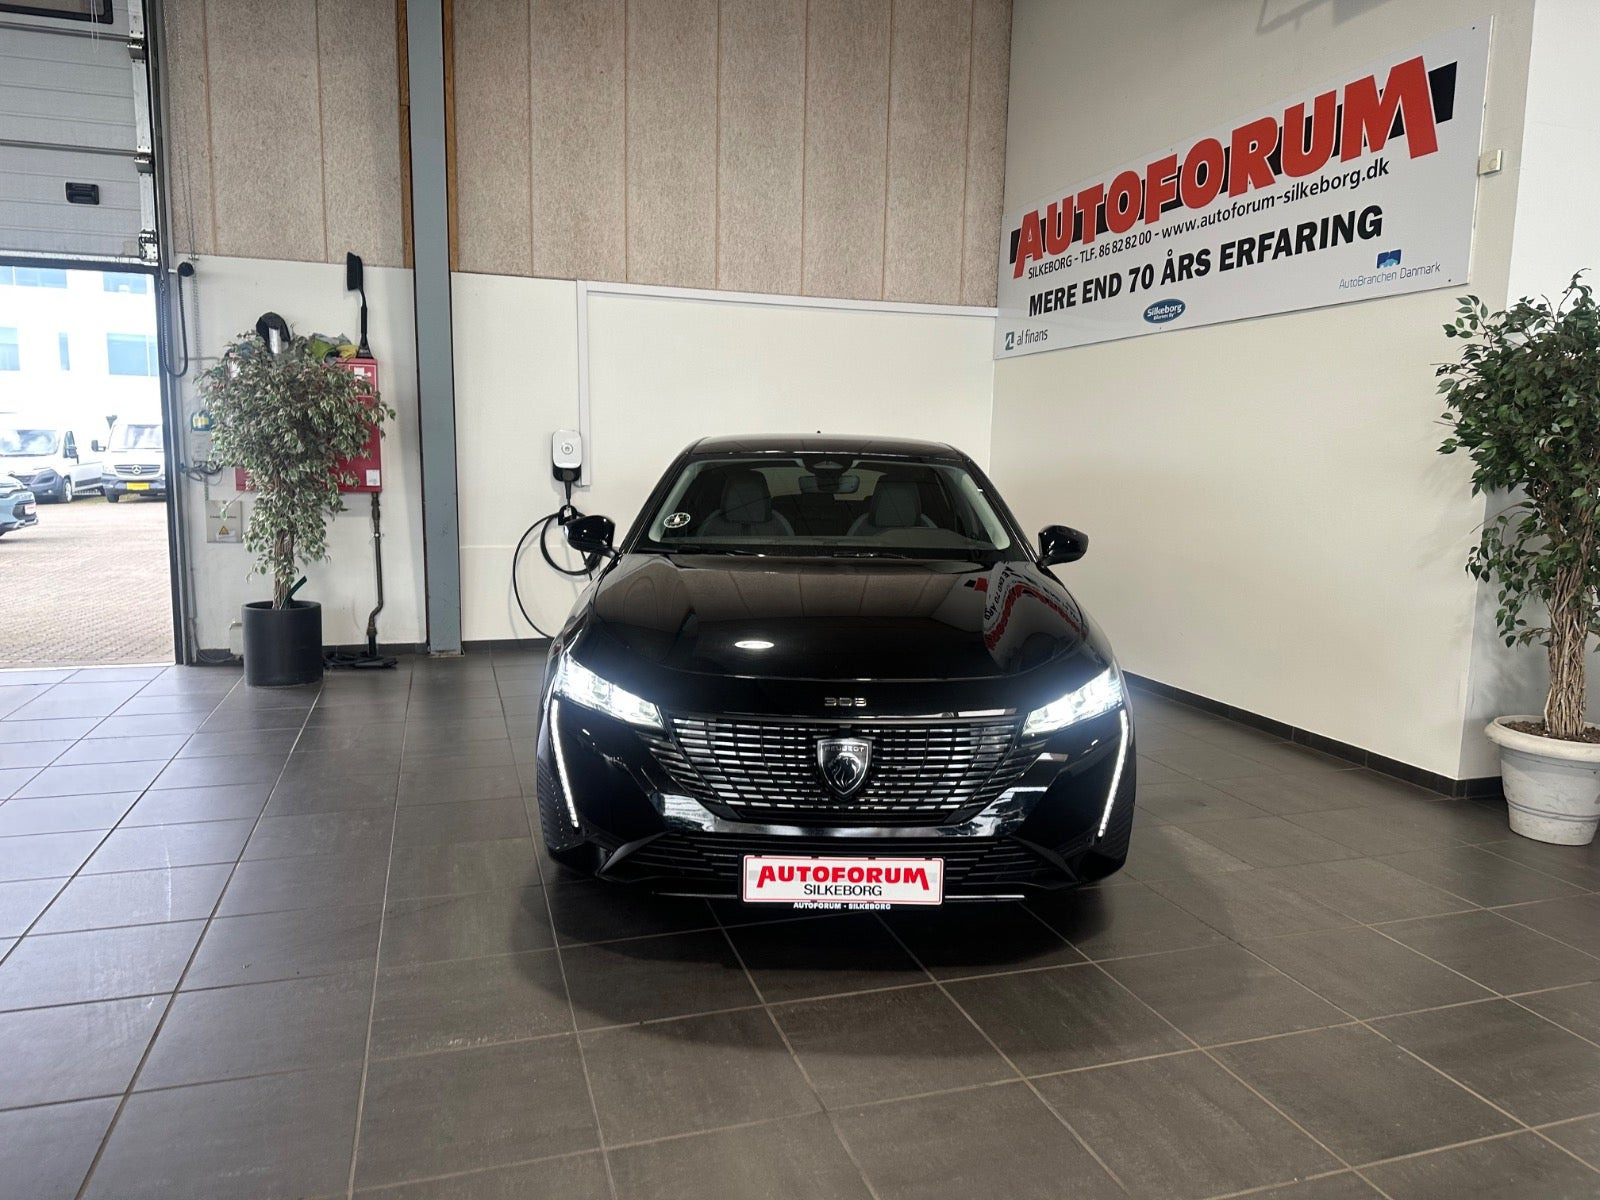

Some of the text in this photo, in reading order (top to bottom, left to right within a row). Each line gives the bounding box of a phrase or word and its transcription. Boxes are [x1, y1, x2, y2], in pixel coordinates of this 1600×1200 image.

[1013, 55, 1438, 279] AUTOFORUM
[1028, 255, 1072, 279] SILKEBORG
[1080, 250, 1098, 263] TLF.
[1161, 157, 1390, 239] www.autoforum-silkeborg.dk
[1029, 204, 1383, 317] MERE END 70 ÅRS ERFARING
[1339, 261, 1441, 289] AutoBranchen Danmark
[1147, 304, 1182, 317] Silkeborg
[824, 697, 867, 707] 308
[756, 865, 930, 891] AUTOFORUM
[803, 883, 882, 897] SILKEBORG
[793, 902, 842, 910] AUTOFORUM
